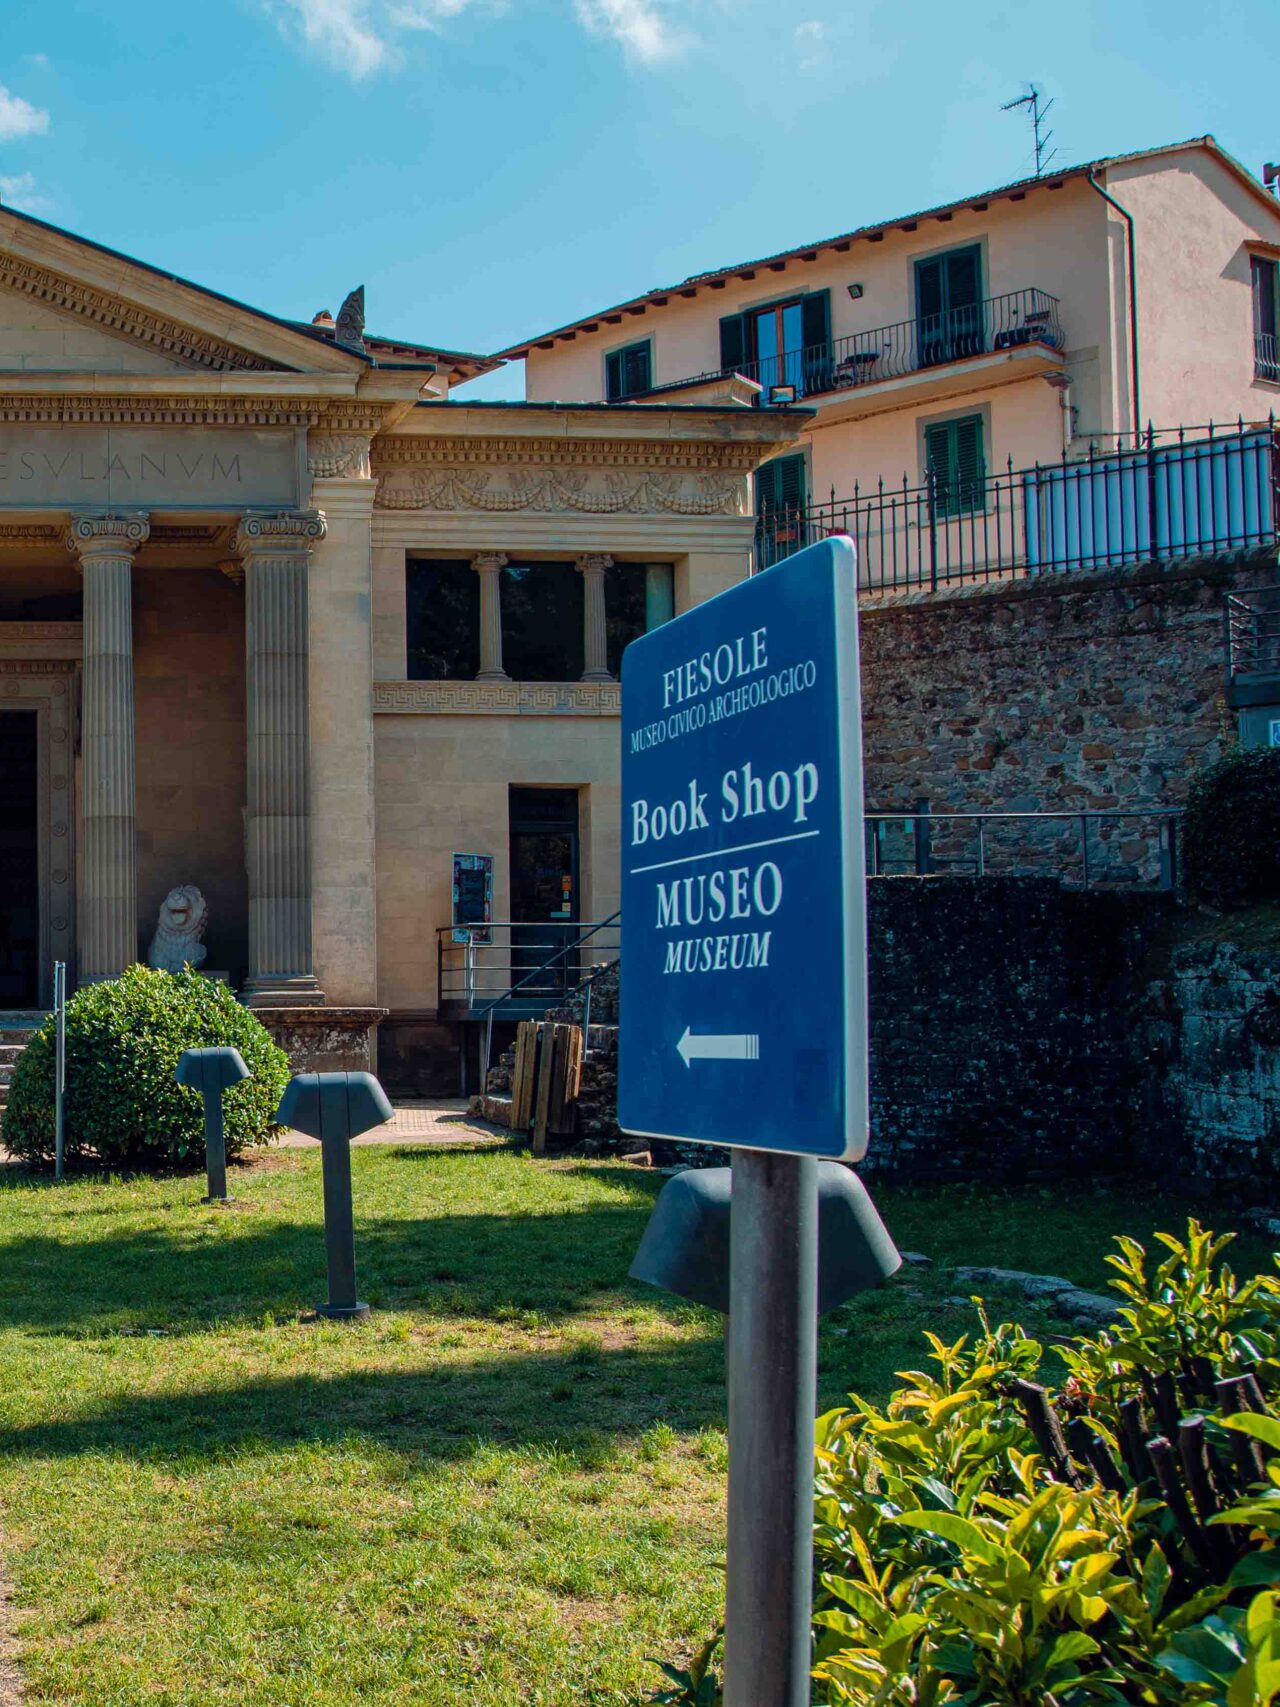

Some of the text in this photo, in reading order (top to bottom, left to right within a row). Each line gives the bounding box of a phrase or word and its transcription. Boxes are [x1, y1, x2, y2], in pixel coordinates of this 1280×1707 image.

[630, 660, 817, 754] MUSEO CIVICO ARCHEOLOGICO
[662, 626, 769, 709] FIESOLE
[631, 761, 819, 846] Book Shop
[655, 861, 783, 929] MUSEO
[663, 931, 772, 974] MUSEUM
